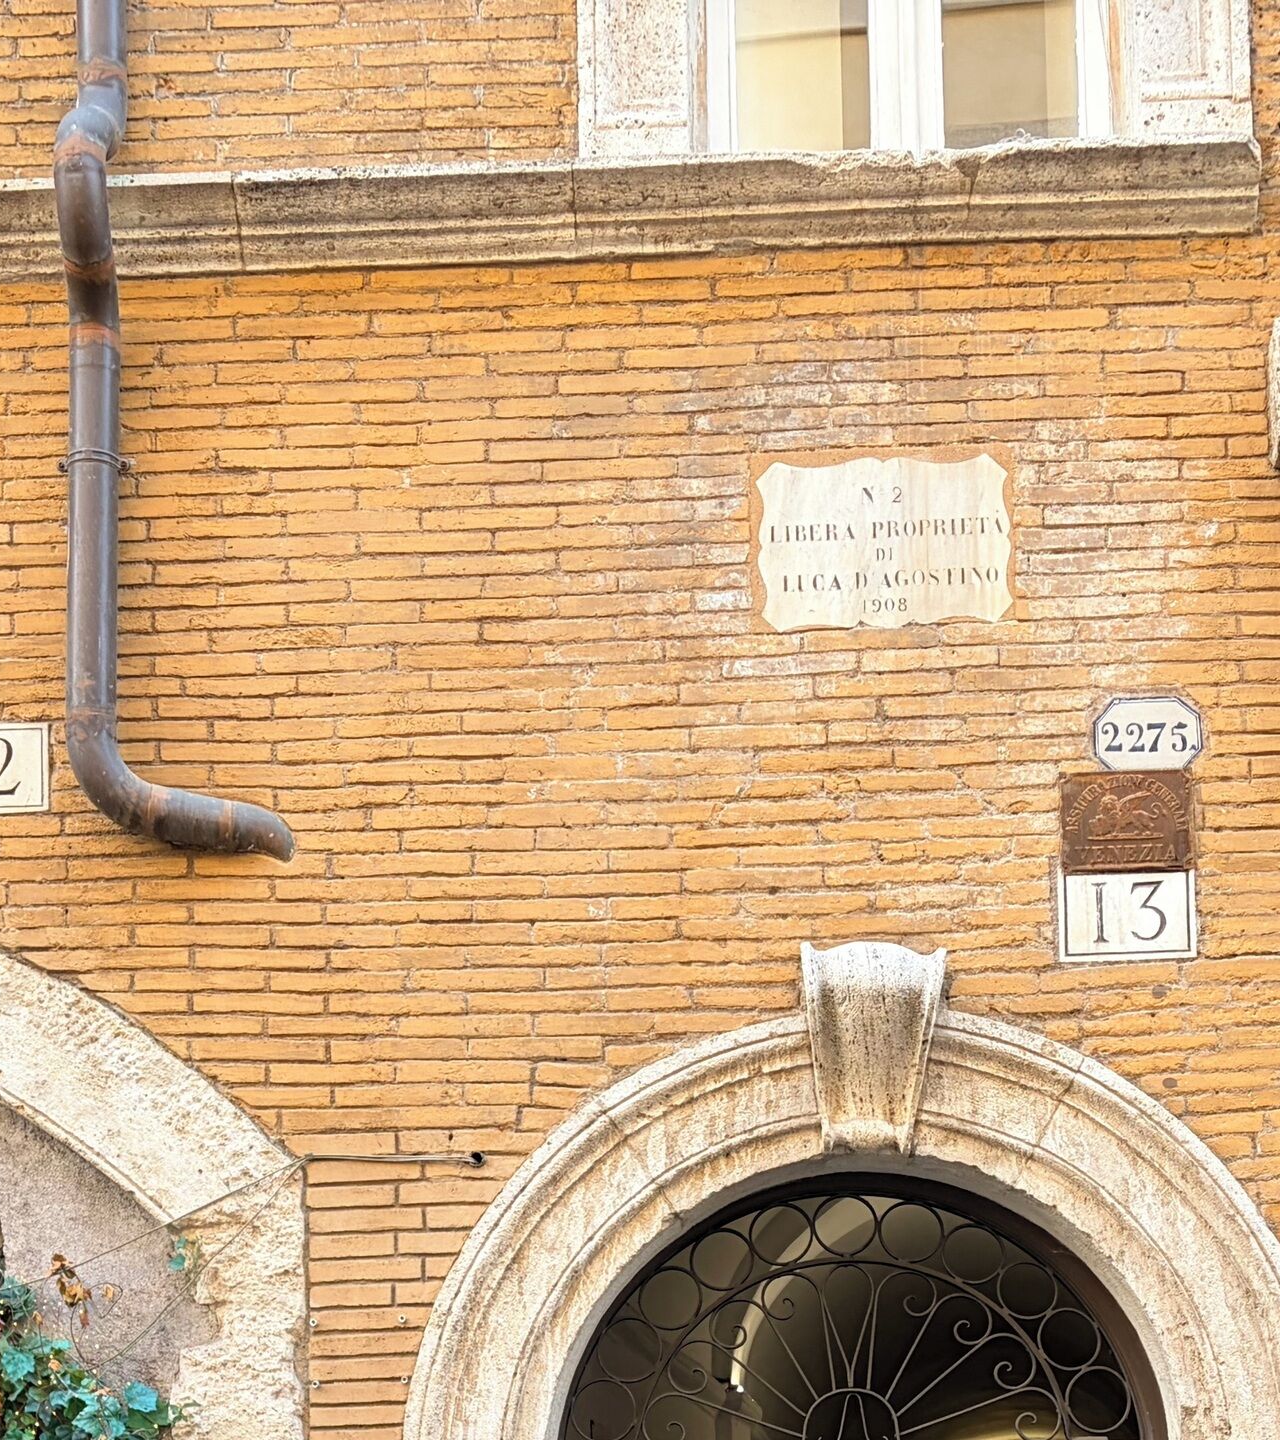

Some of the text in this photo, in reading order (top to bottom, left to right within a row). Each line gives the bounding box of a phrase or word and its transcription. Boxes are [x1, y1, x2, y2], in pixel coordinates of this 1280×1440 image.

[892, 486, 903, 504] 2
[770, 523, 855, 543] LIBERA
[876, 547, 893, 561] DI
[783, 573, 842, 593] LUCA
[863, 597, 908, 614] 1908
[1074, 844, 1176, 864] VENEZIA
[1091, 880, 1168, 944] 13
